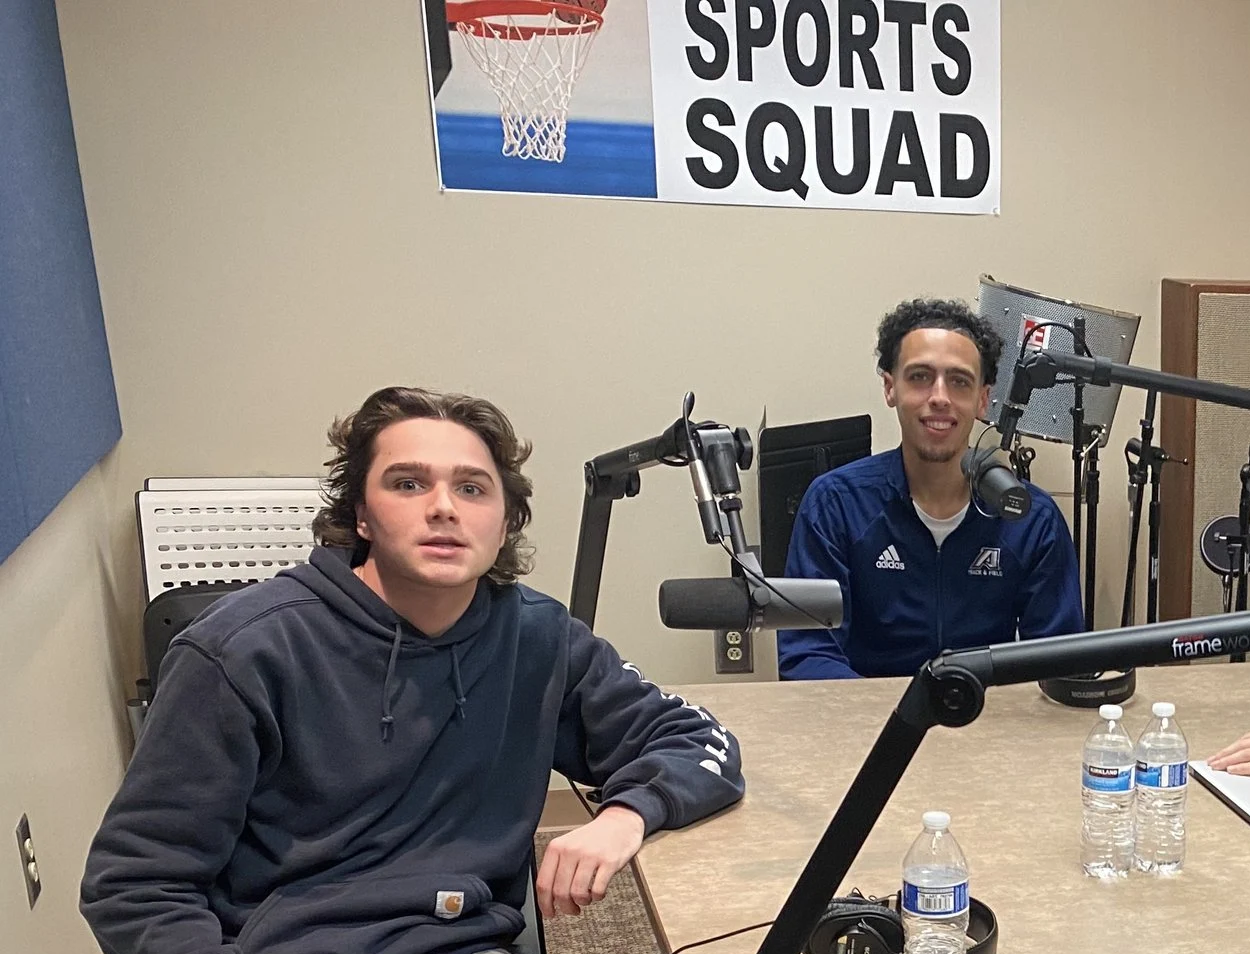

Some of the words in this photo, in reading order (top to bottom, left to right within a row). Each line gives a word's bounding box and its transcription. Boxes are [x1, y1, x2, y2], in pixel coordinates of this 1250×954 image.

[684, 0, 972, 96] SPORTS
[685, 97, 991, 201] SQUAD
[875, 559, 905, 570] adidas
